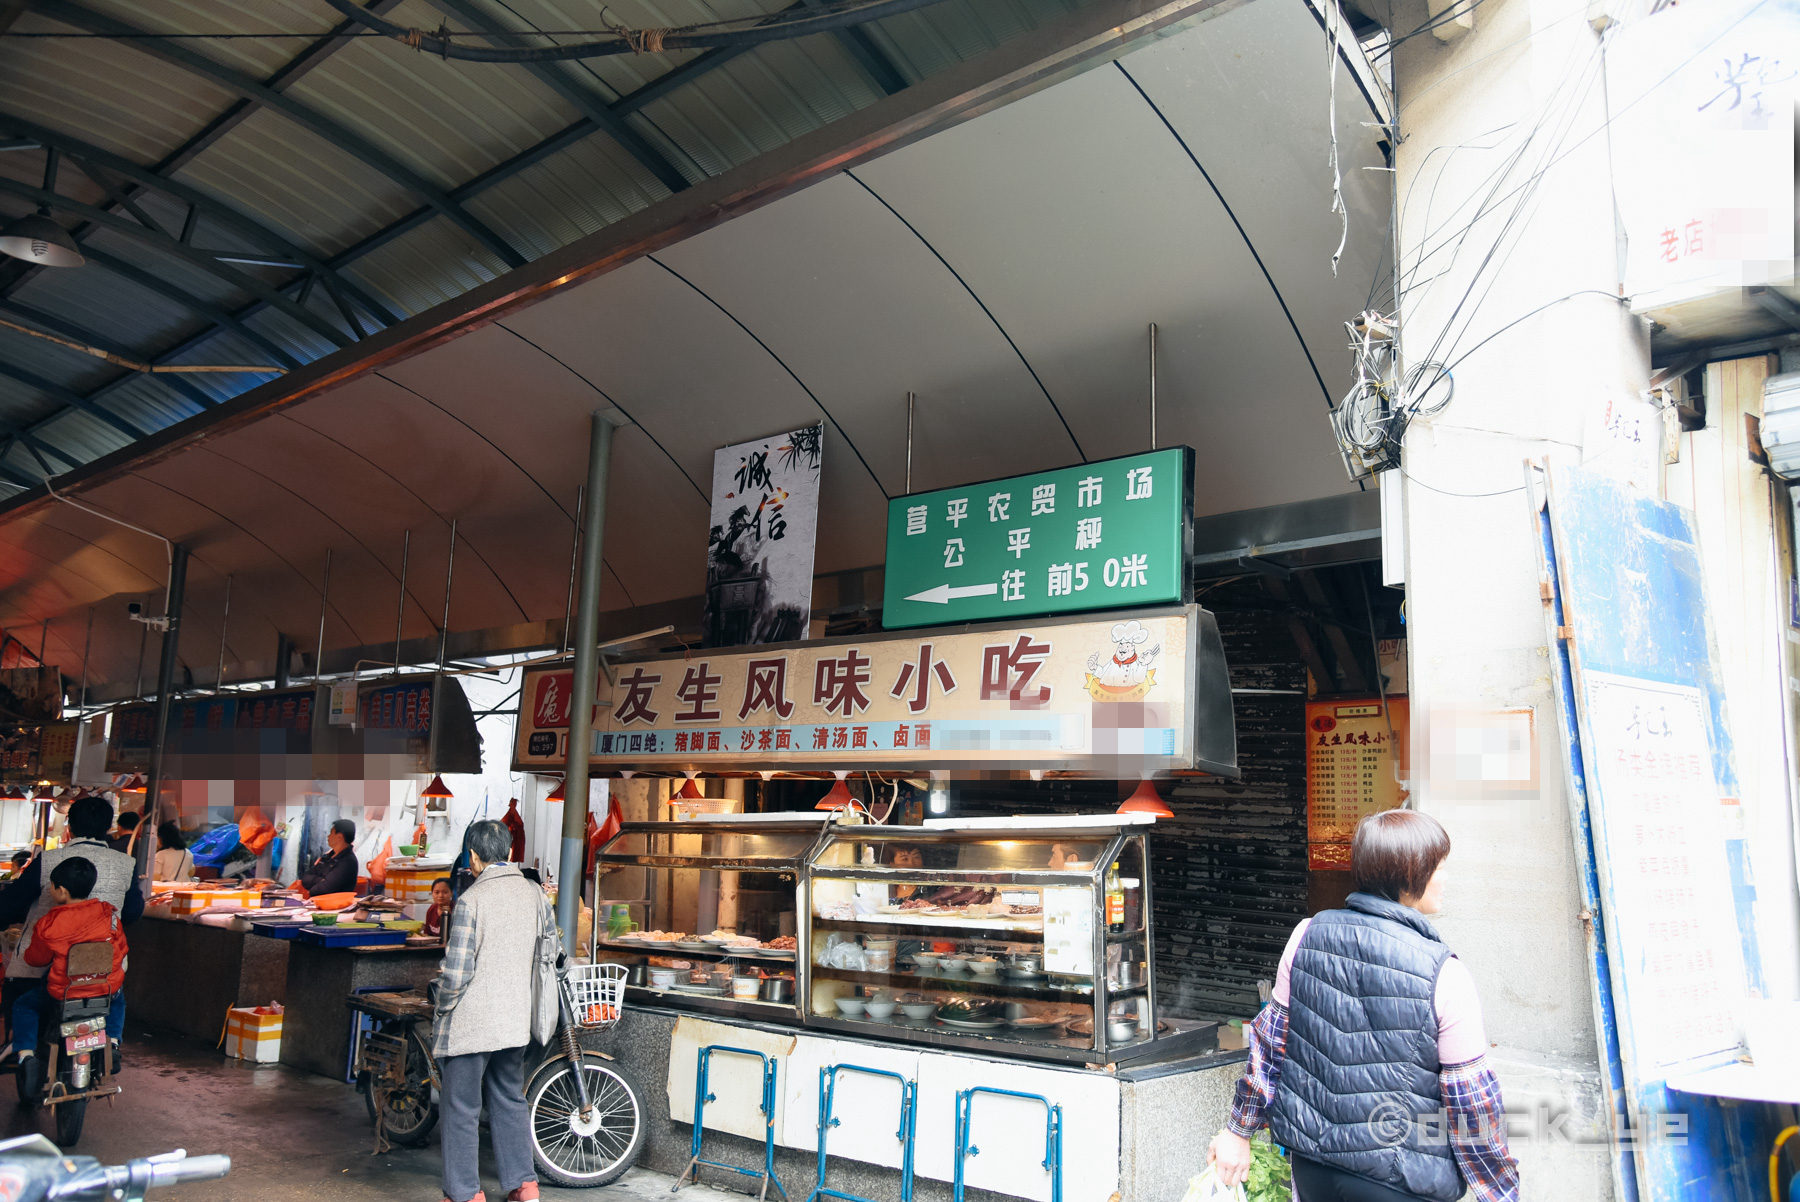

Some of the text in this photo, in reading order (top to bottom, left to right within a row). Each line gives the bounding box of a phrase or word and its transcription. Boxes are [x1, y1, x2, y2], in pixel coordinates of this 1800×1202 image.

[734, 444, 790, 542] 诚信
[906, 466, 1153, 536] 营平农贸市场
[943, 516, 1102, 568] 公平秤
[613, 633, 1055, 727] 友生风味小吃
